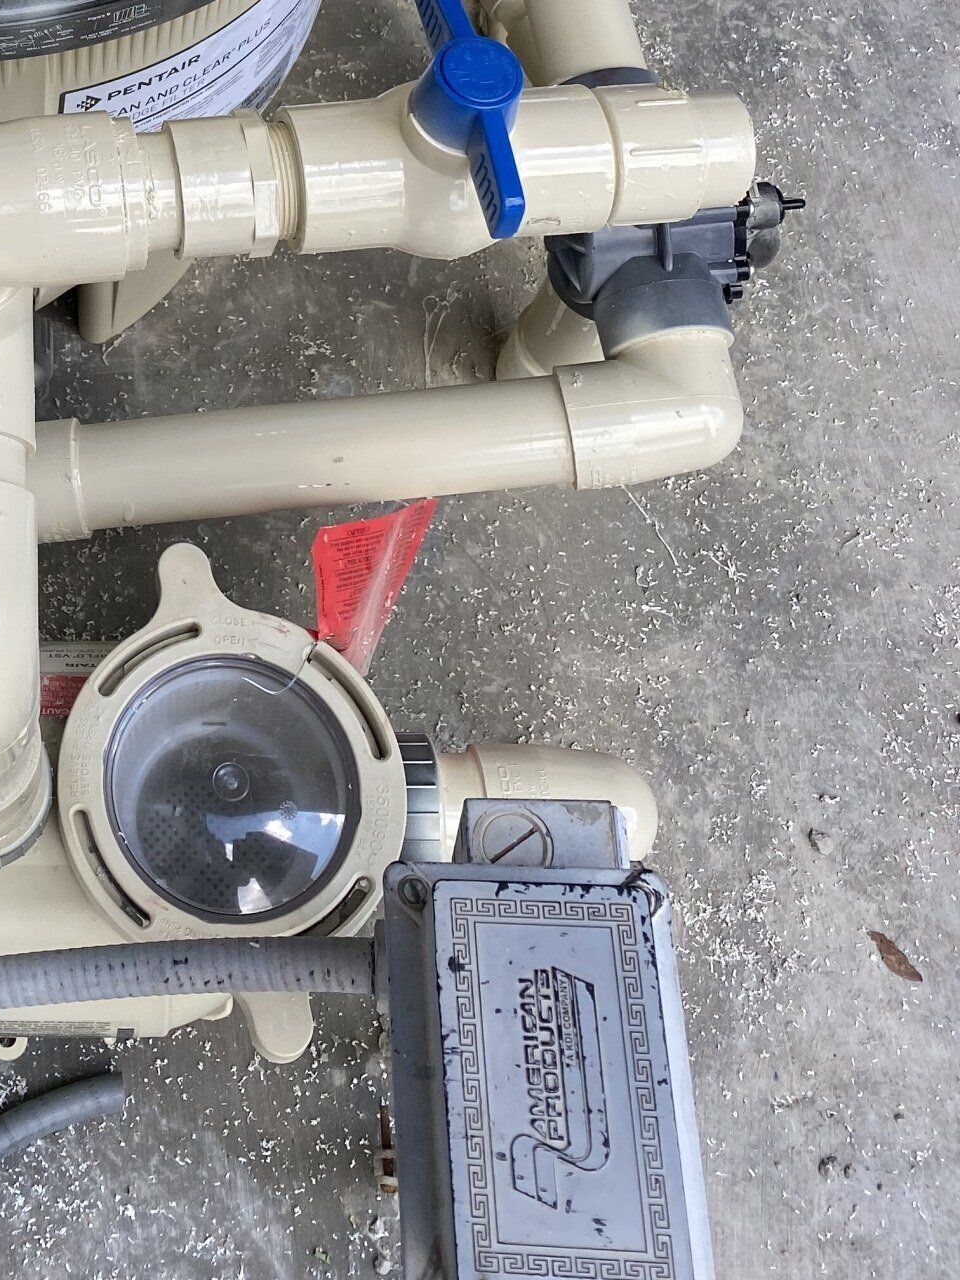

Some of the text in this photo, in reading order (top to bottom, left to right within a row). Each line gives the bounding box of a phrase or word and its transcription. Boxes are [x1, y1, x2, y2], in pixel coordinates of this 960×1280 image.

[107, 54, 201, 101] PENTAIR
[145, 84, 179, 106] AND
[182, 51, 231, 86] CLEAR
[237, 17, 271, 52] PLUS
[162, 78, 206, 107] FILTER
[211, 616, 247, 628] CLOSE
[214, 635, 245, 647] OPEN
[558, 979, 574, 1062] A KDI COMPANY
[518, 978, 546, 1139] AMERICAN
[538, 969, 564, 1141] PRODUCTS
